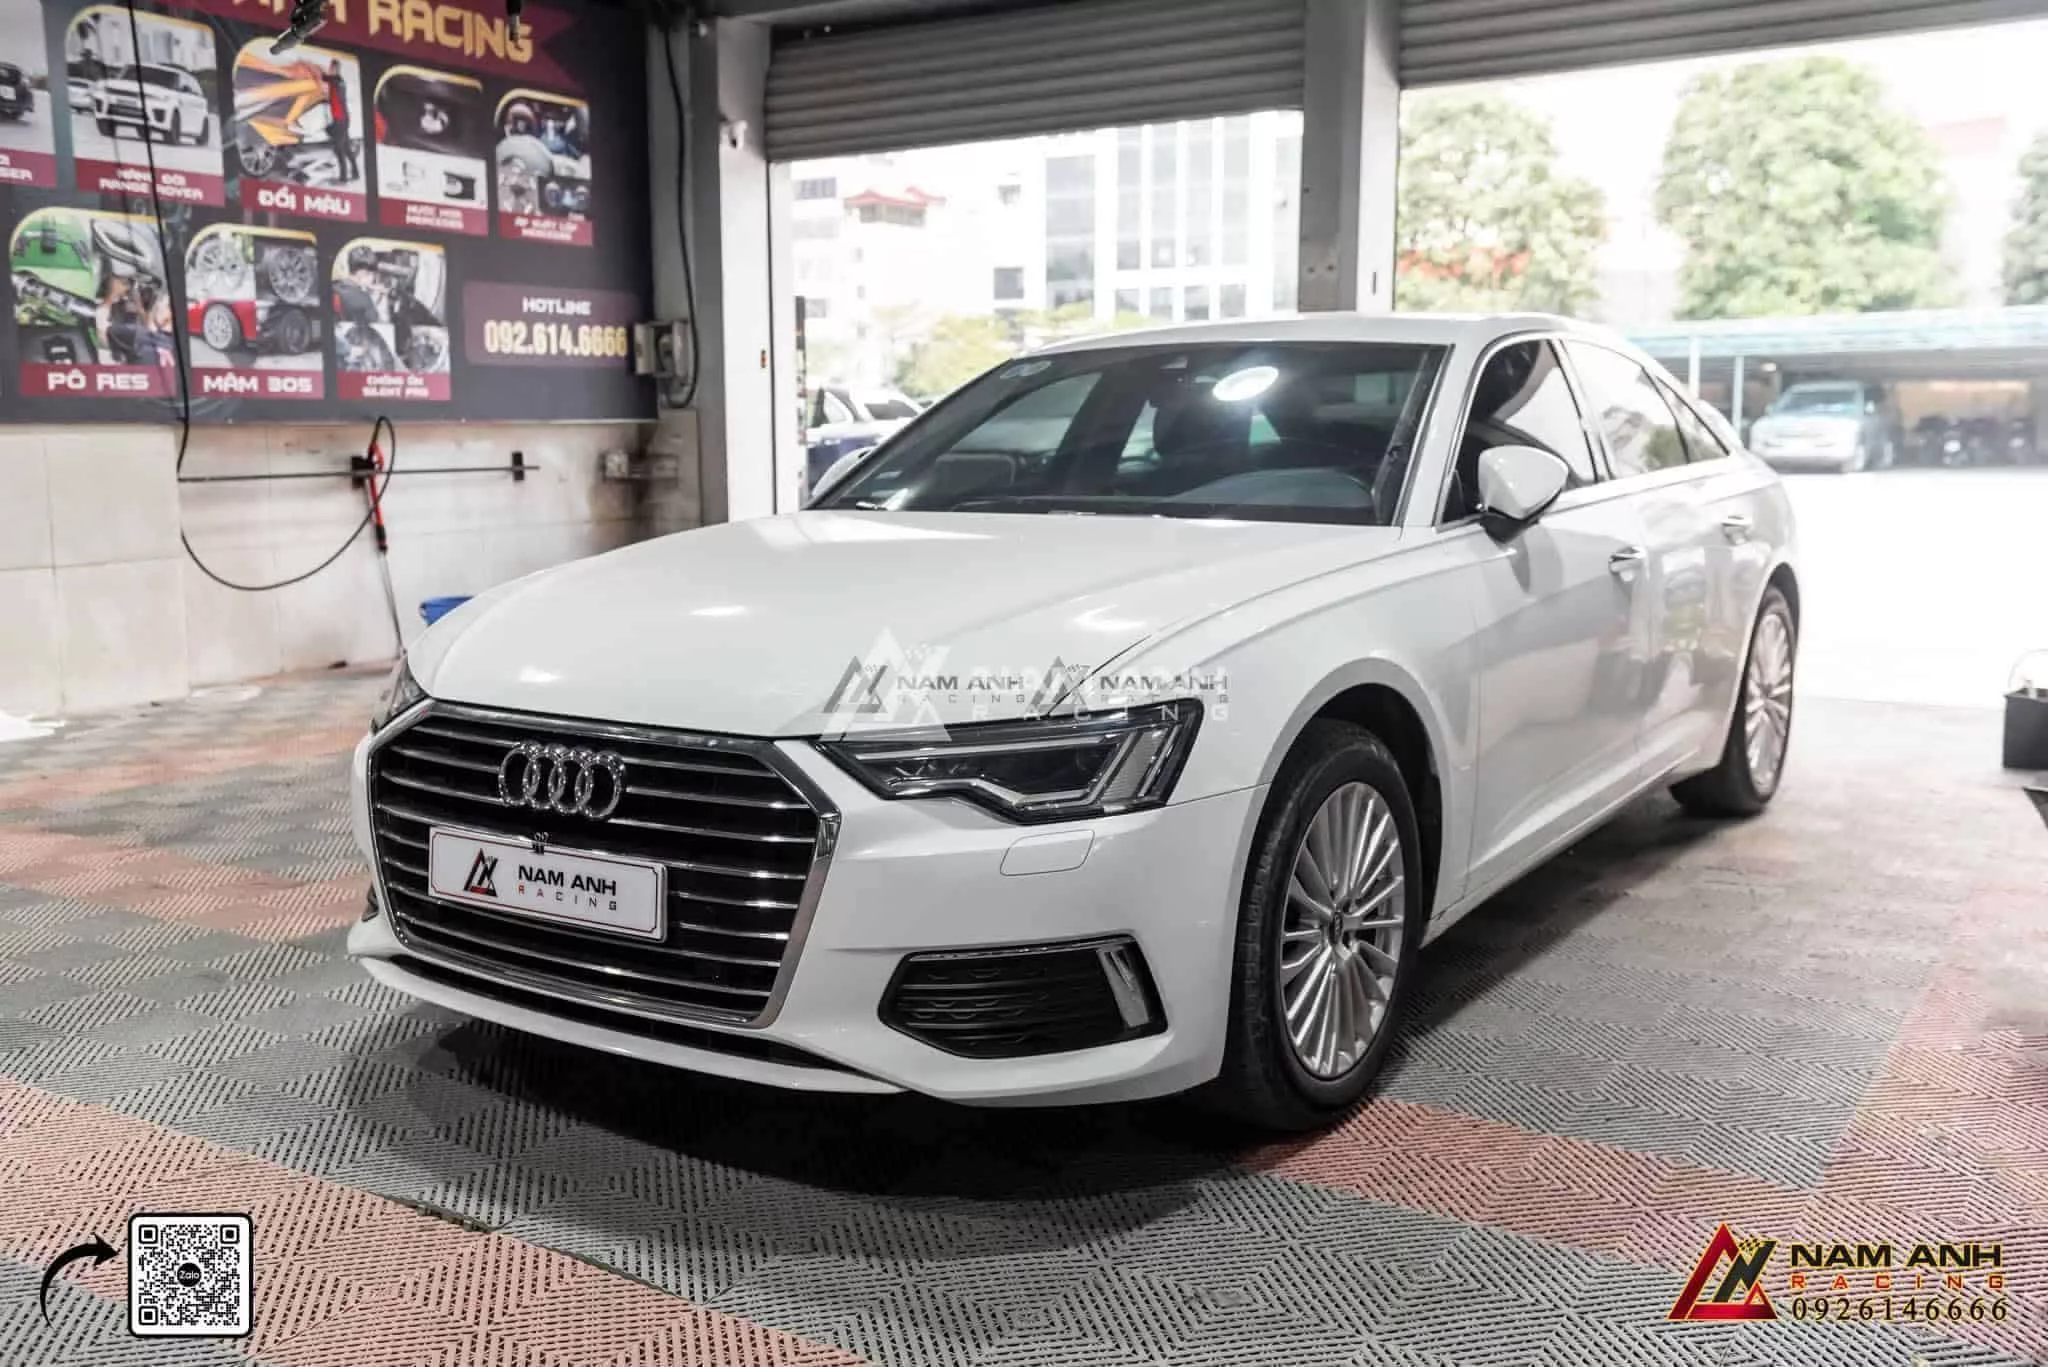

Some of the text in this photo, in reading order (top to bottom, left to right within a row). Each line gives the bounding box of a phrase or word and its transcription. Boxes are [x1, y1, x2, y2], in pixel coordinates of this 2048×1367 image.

[367, 0, 534, 64] RACING
[522, 297, 592, 316] HOTLINE
[484, 319, 628, 357] 092.614.6666
[47, 369, 150, 391] PÔ RES
[202, 371, 259, 393] MÂM
[518, 864, 617, 897] NAM ANH
[518, 884, 617, 911] RACING
